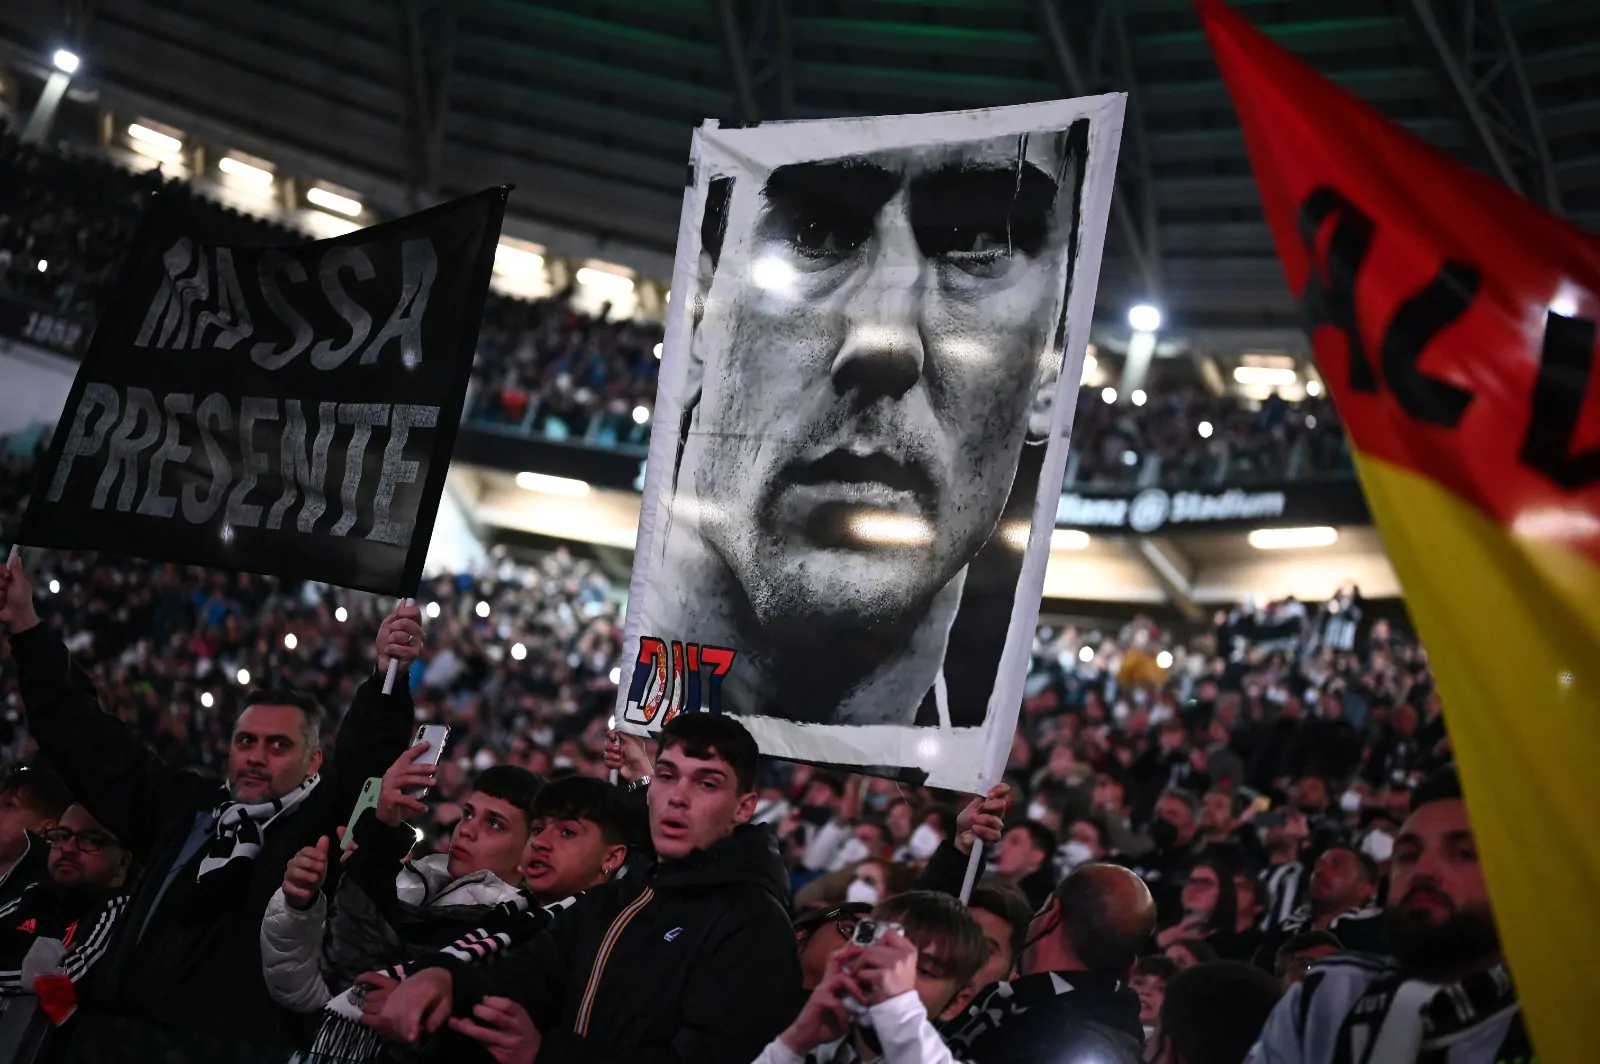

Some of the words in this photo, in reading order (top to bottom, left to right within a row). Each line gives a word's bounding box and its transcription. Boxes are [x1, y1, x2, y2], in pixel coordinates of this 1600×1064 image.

[134, 236, 438, 371] MASSA
[45, 382, 441, 545] PRESENTE
[1172, 491, 1284, 522] Stadium
